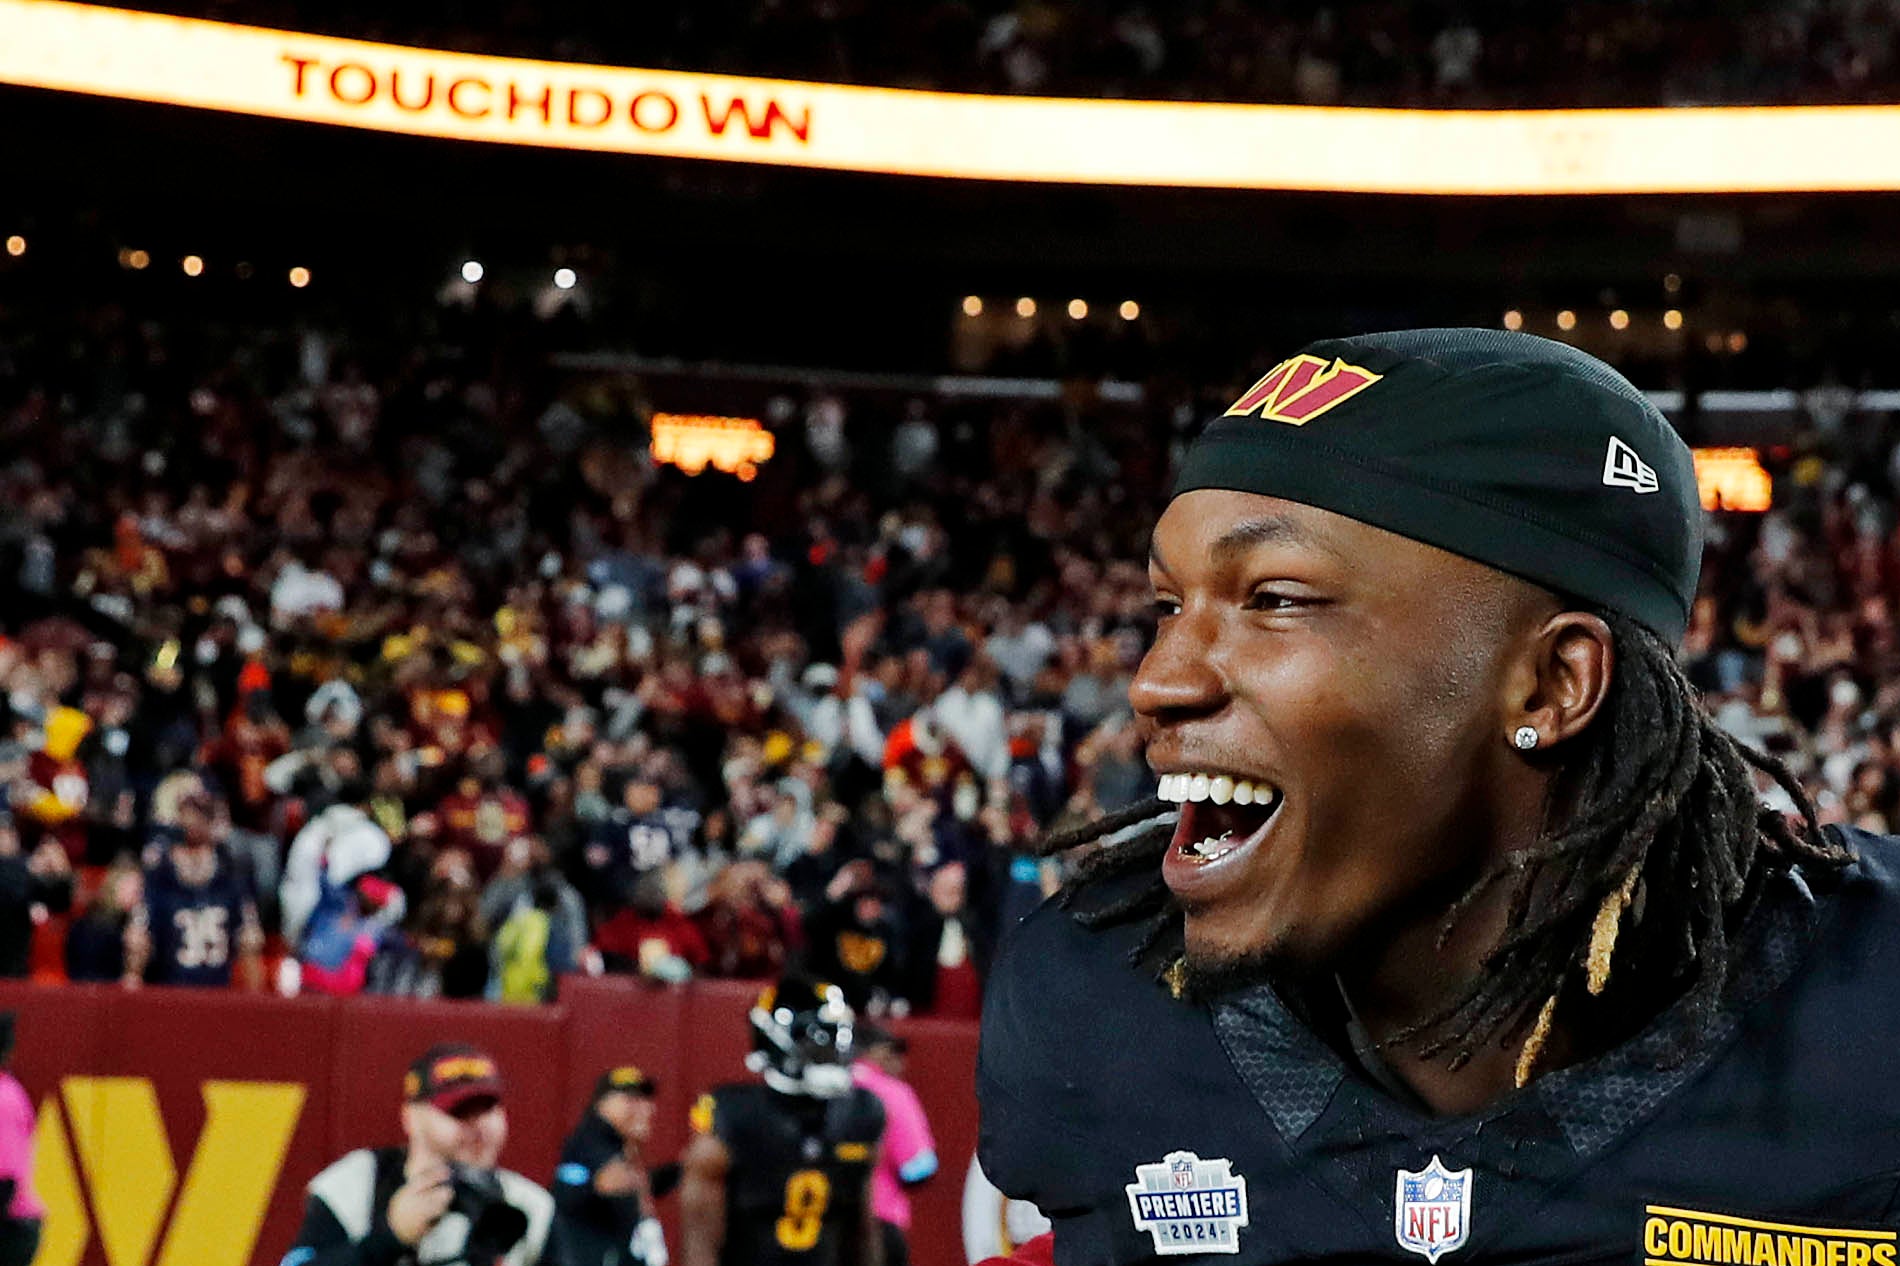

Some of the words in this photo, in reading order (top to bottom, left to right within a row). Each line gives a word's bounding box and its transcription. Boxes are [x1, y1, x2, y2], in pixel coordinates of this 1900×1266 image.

[281, 54, 811, 145] TOUCHDOWN
[1173, 1170, 1193, 1188] NFL
[1408, 1206, 1457, 1243] NFL
